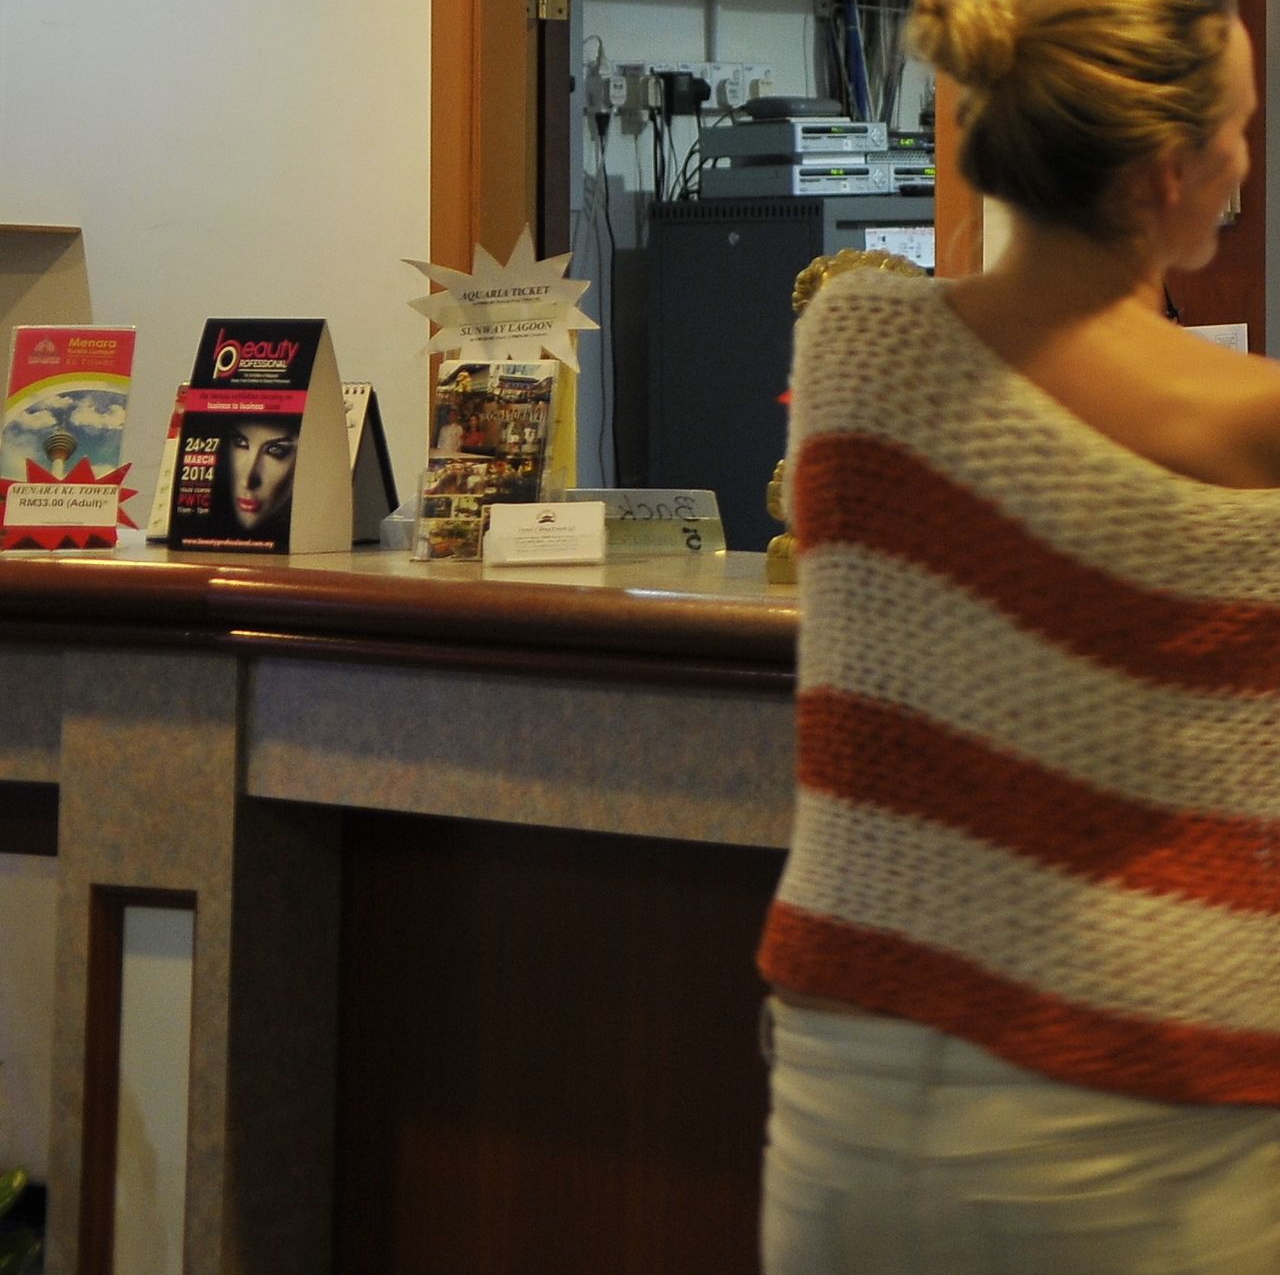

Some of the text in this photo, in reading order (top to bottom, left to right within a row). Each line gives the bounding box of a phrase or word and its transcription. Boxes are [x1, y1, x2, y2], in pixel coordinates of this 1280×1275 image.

[460, 288, 508, 302] AQUARIA
[512, 285, 550, 297] TICKET
[459, 320, 555, 336] SUNWAY LAGOON
[68, 337, 118, 349] Menara
[183, 454, 214, 465] MARCH
[181, 466, 214, 481] 2014
[12, 485, 59, 496] MENARA
[78, 486, 118, 496] TOWER
[18, 498, 64, 508] RM33.00
